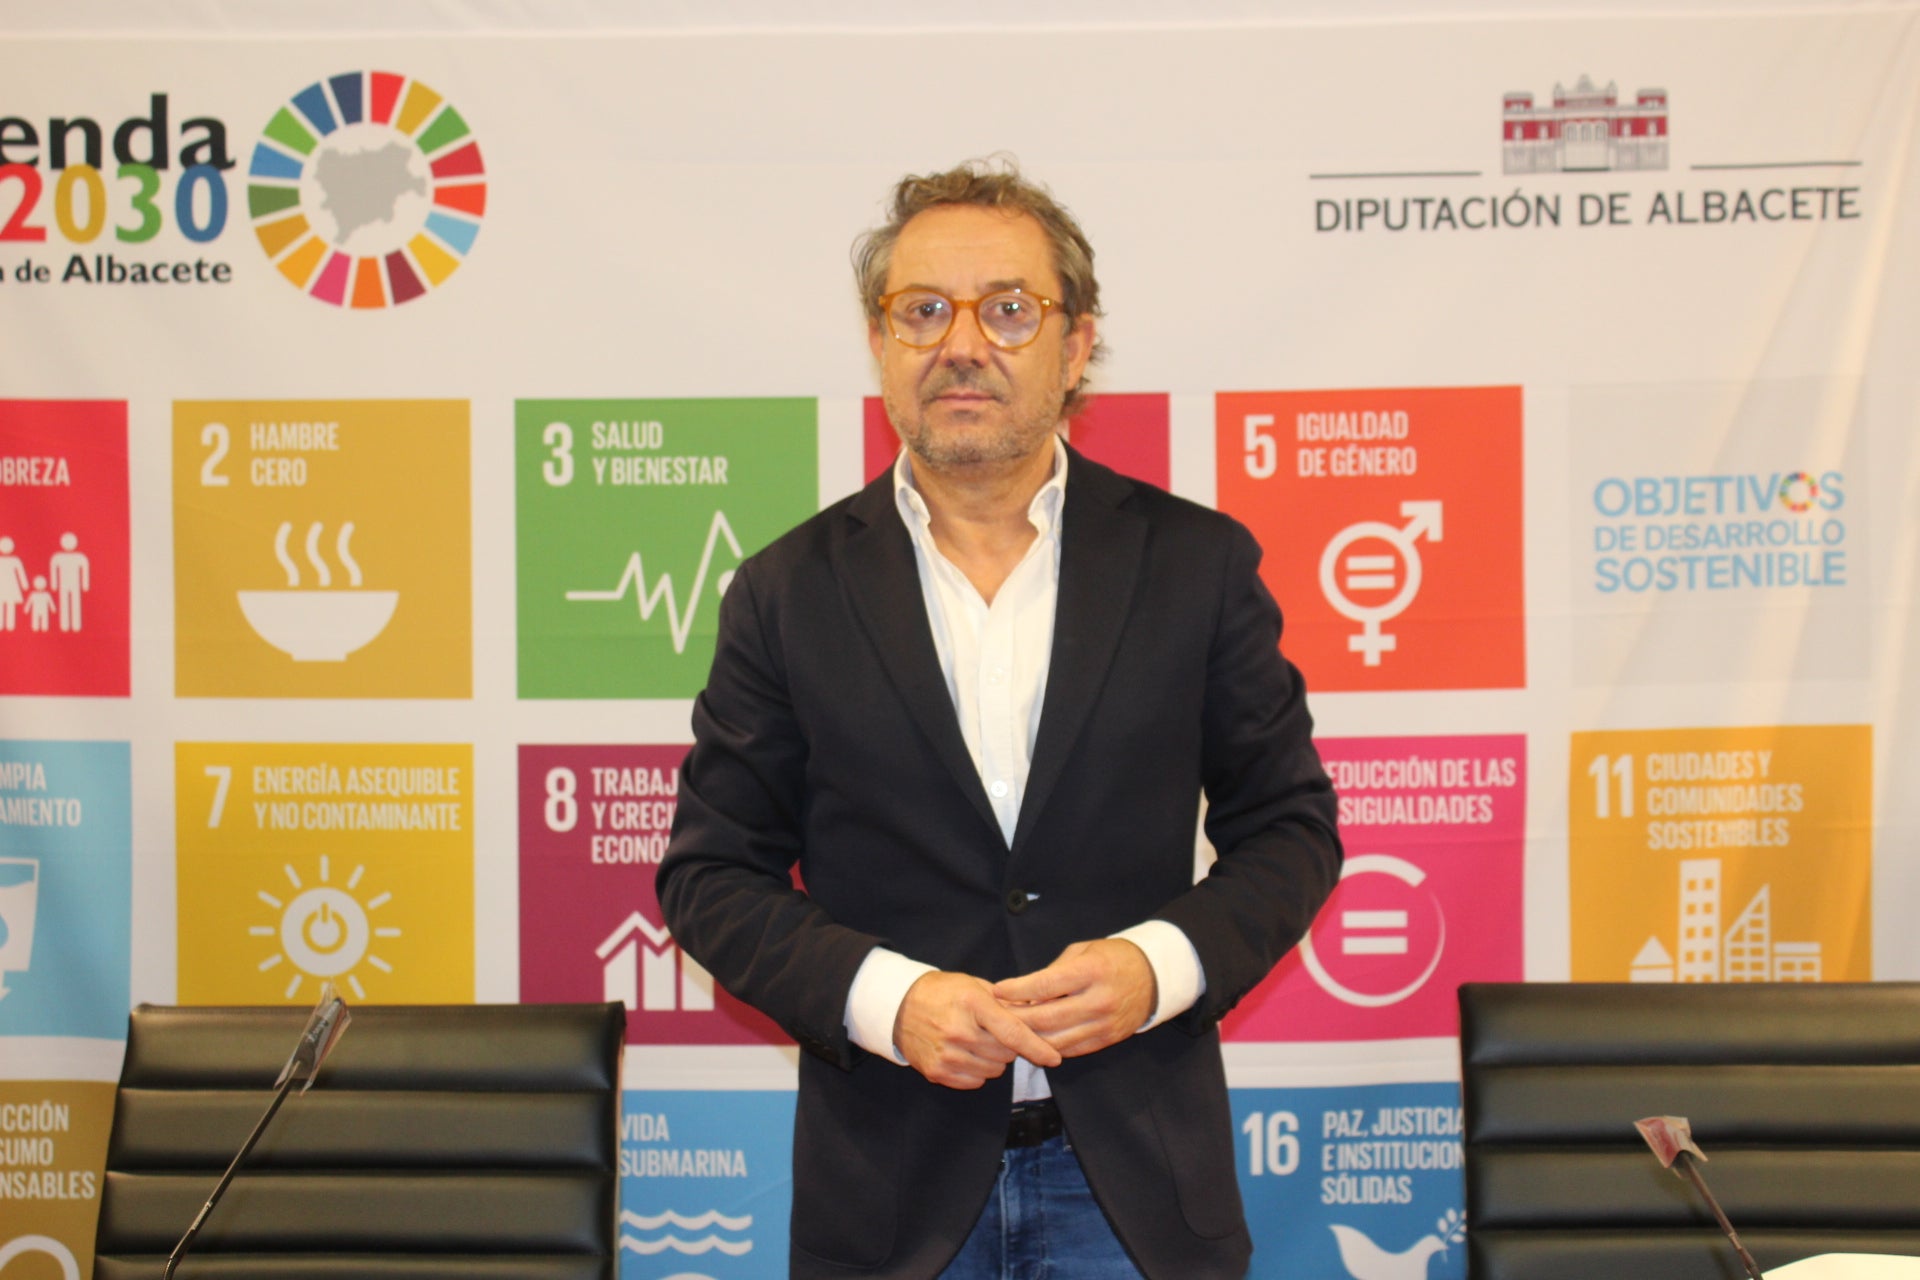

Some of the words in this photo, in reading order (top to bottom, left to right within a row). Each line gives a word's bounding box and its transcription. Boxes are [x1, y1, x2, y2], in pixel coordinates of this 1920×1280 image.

[0, 92, 236, 170] enda
[0, 162, 228, 244] 2030
[1315, 188, 1561, 232] DIPUTACIÓN
[1578, 193, 1631, 225] DE
[1647, 187, 1861, 223] ALBACETE
[15, 258, 51, 282] de
[62, 253, 232, 283] Albacete
[250, 421, 339, 452] HAMBRE
[592, 421, 663, 450] SALUD
[1296, 410, 1409, 441] IGUALDAD
[200, 422, 230, 487] 2
[542, 422, 575, 487] 3
[1244, 414, 1277, 480] 5
[1298, 448, 1327, 477] DE
[1330, 443, 1417, 477] GÉNERO
[0, 456, 71, 487] BREZA
[250, 457, 307, 487] CERO
[592, 457, 608, 485] Y
[611, 456, 728, 485] BIENESTAR
[1593, 471, 1846, 517] OBJETIVOS
[1594, 525, 1637, 552] DE
[1644, 518, 1846, 551] DESARROLLO
[1594, 550, 1846, 594] SOSTENIBLE
[253, 762, 342, 795] ENERGÍA
[346, 766, 460, 798] ASEQUIBLE
[1322, 756, 1438, 790] EDUCCIÓN
[1441, 759, 1470, 788] DE
[1474, 757, 1517, 787] LAS
[1646, 751, 1754, 782] CIUDADES
[1758, 750, 1774, 777] Y
[204, 766, 232, 828] 7
[544, 767, 578, 832] 8
[1588, 754, 1634, 819] 11
[1646, 783, 1804, 816] COMUNIDADES
[254, 802, 268, 829] Y
[271, 802, 299, 829] NO
[303, 803, 461, 831] CONTAMINANTE
[591, 802, 606, 830] Y
[610, 802, 677, 831] CRECI
[591, 831, 670, 864] ECONÓ
[1646, 818, 1790, 850] SOSTENIBLES
[0, 1100, 69, 1132] CCIÓN
[621, 1113, 669, 1141] VIDA
[1323, 1110, 1368, 1139] PAZ,
[1242, 1111, 1300, 1176] 16
[1322, 1145, 1334, 1171] E
[620, 1149, 747, 1177] SUBMARINA
[1321, 1174, 1411, 1204] SÓLIDAS
